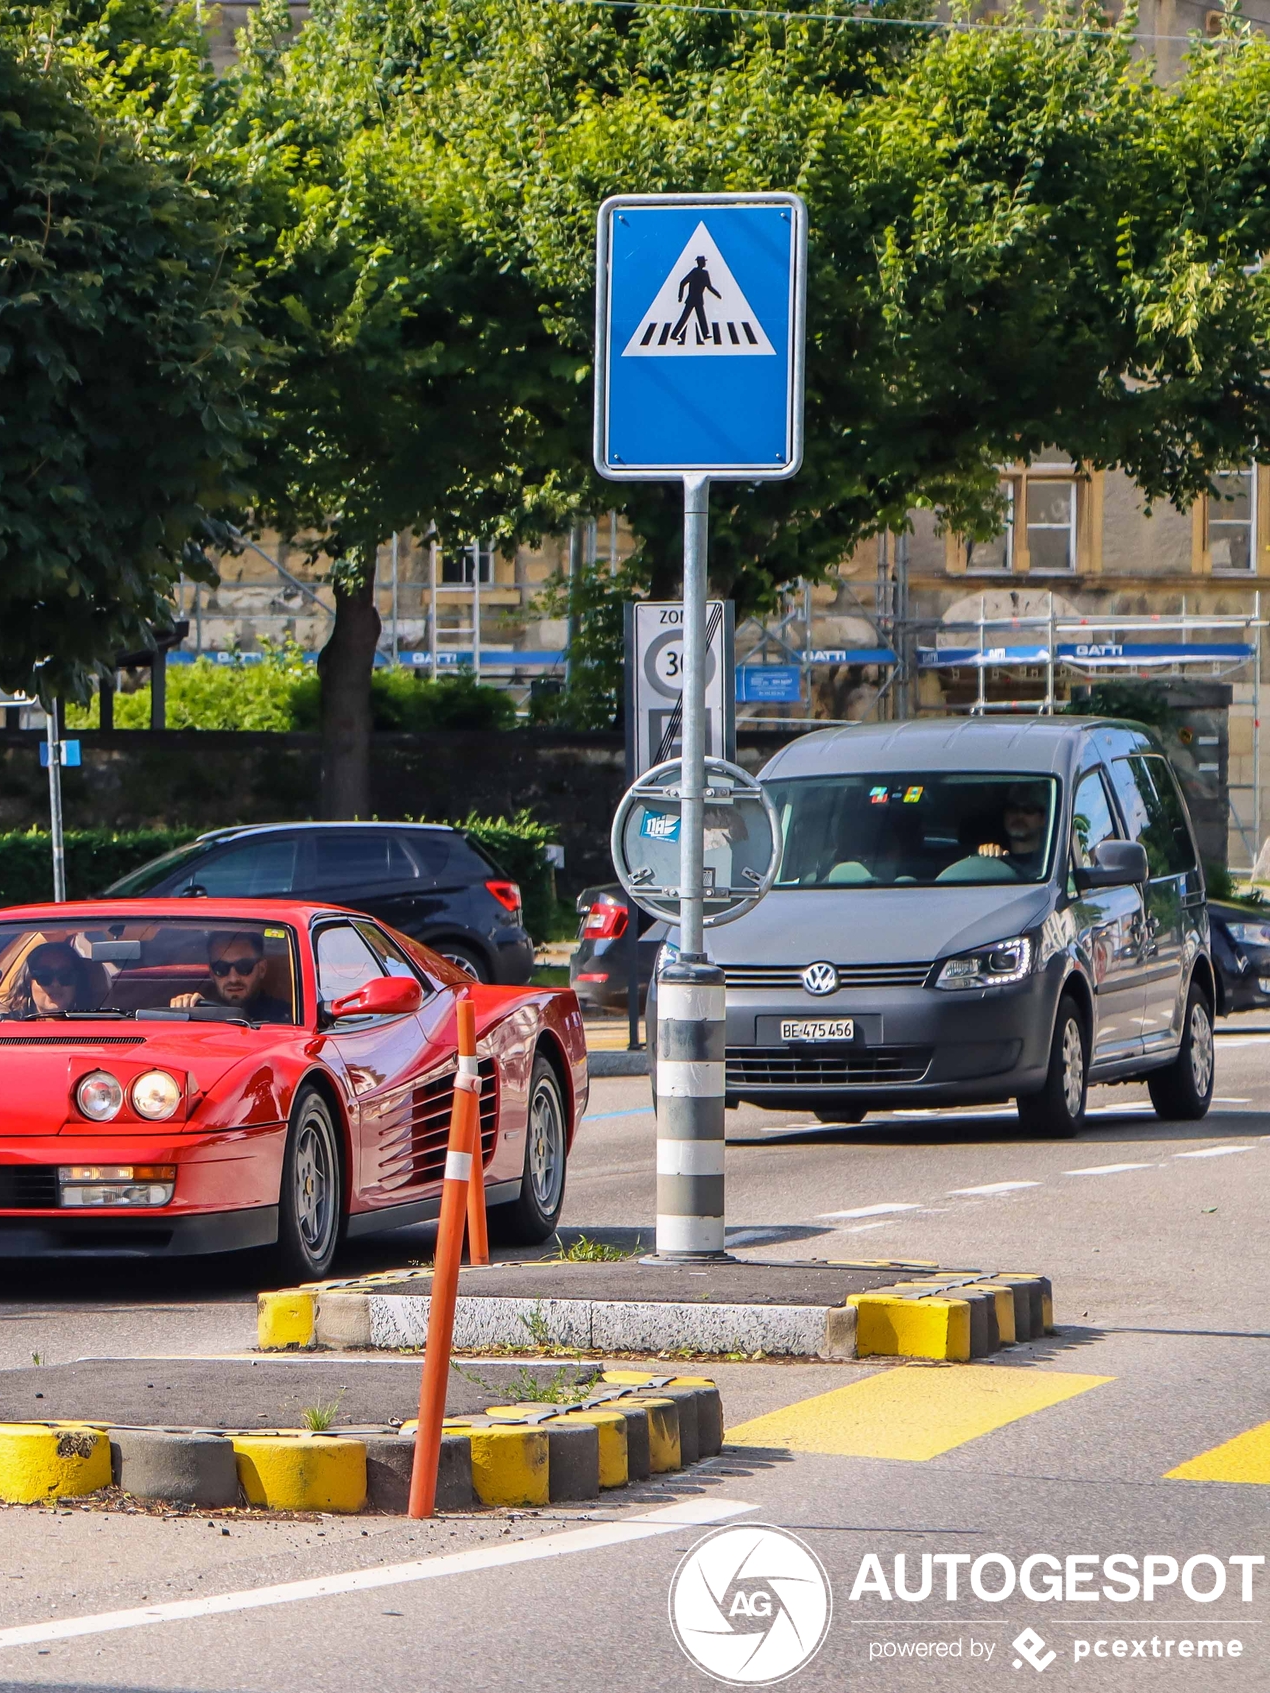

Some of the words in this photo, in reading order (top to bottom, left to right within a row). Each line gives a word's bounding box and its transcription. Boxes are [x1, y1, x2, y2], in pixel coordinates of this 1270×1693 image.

[660, 610, 684, 624] ZO
[1076, 644, 1123, 656] GATTI
[666, 651, 684, 676] 3
